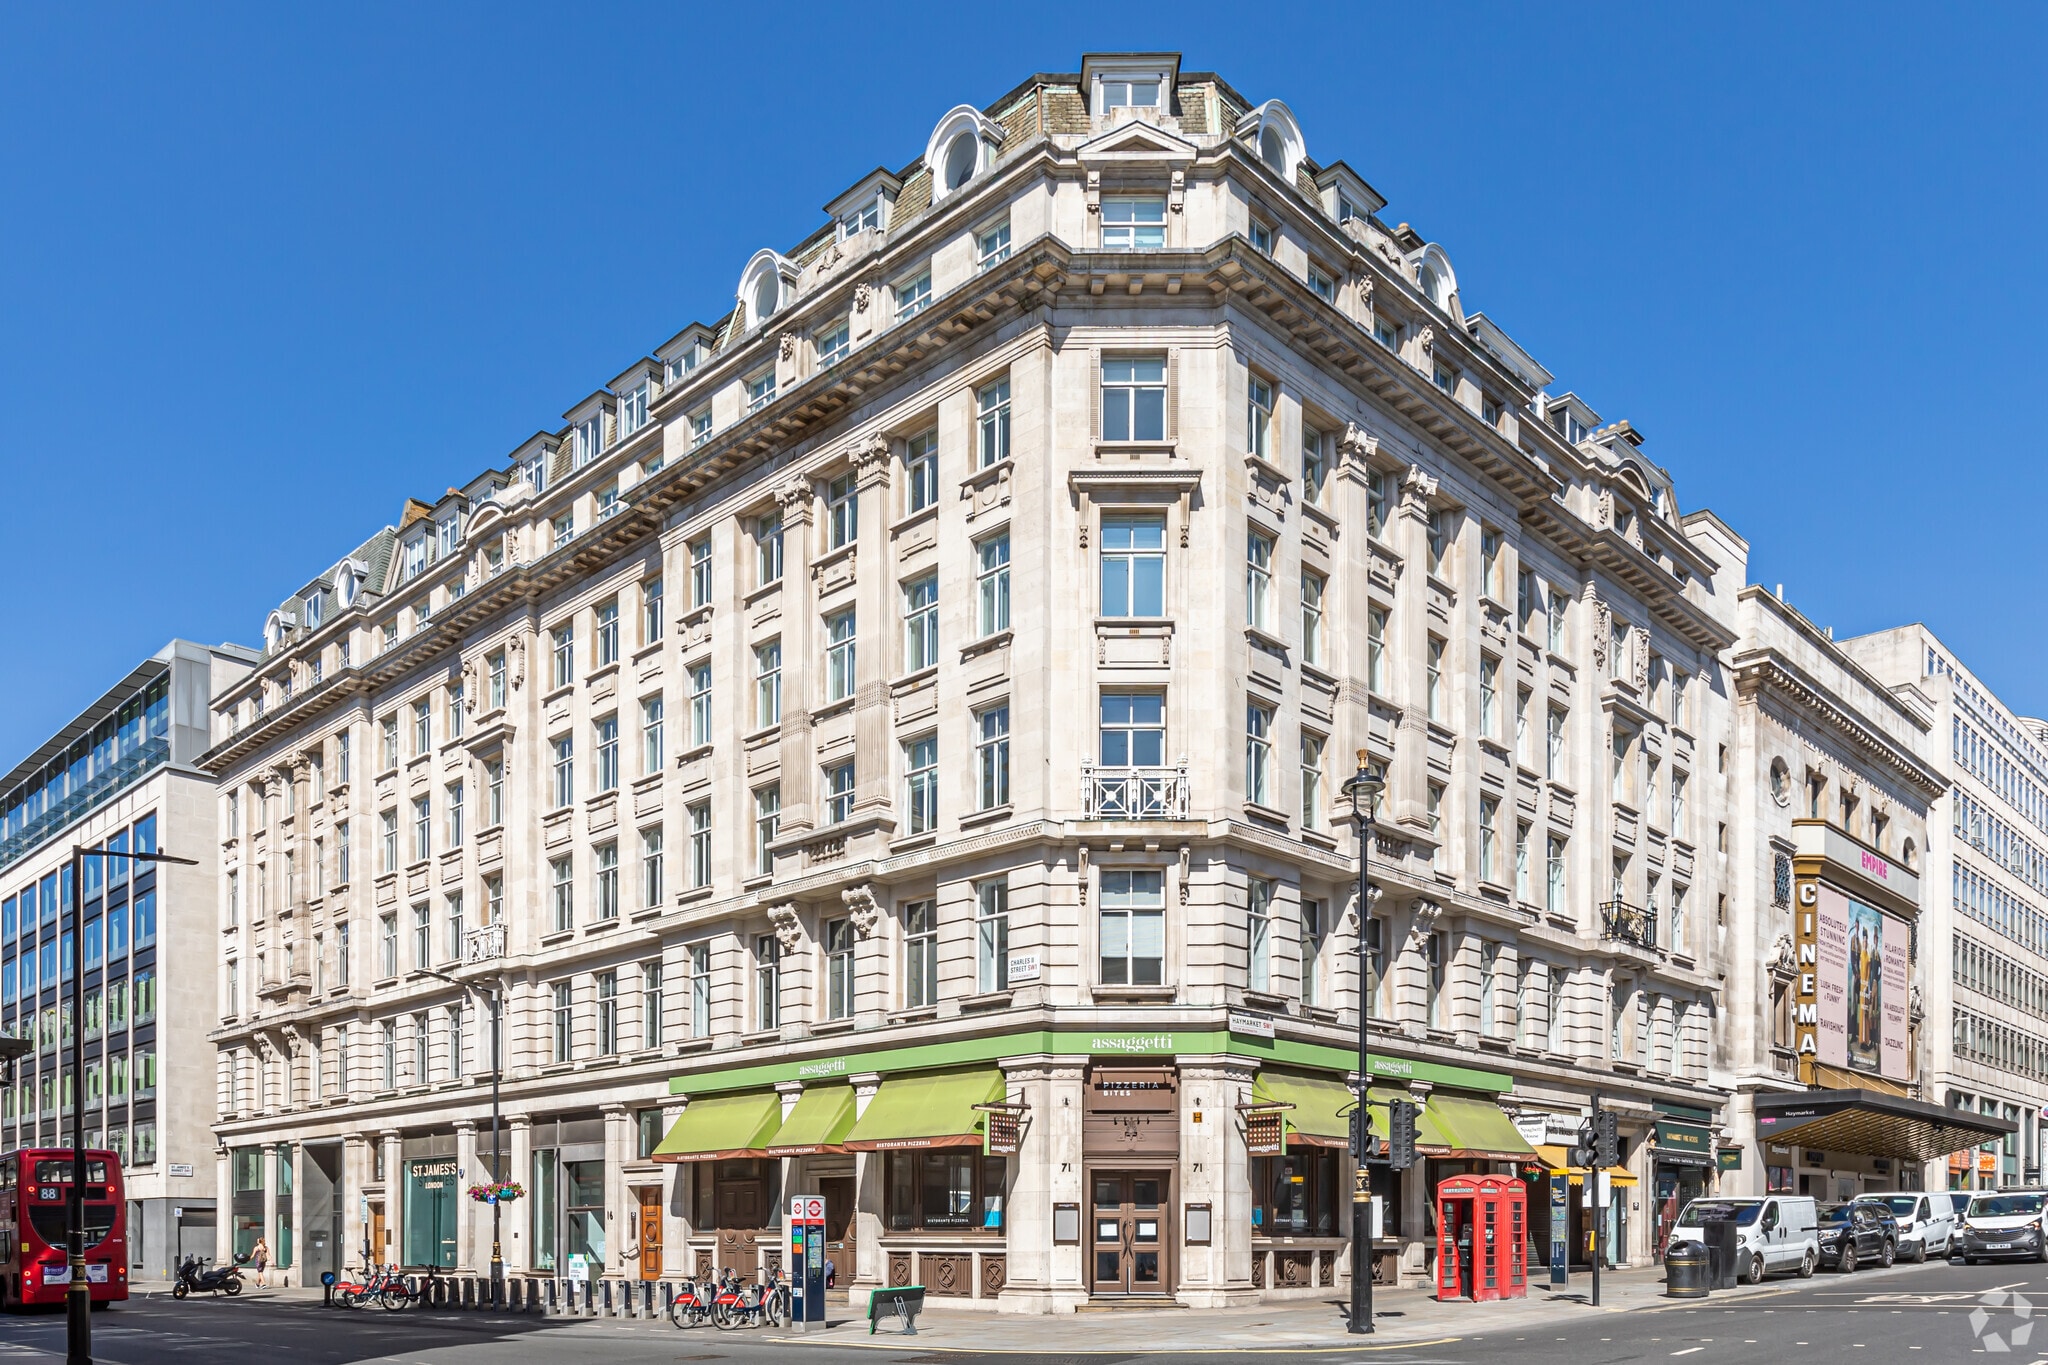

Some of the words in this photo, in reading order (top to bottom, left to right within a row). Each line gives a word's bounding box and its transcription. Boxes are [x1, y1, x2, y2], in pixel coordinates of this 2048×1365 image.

[1862, 850, 1887, 880] EMPIRE
[1820, 926, 1845, 945] STUNNING
[1010, 957, 1030, 967] CHARLES
[1010, 965, 1027, 974] STREET
[1027, 964, 1038, 972] SW1
[1799, 884, 1817, 1054] CINEMA
[1831, 984, 1844, 995] FRESH
[1231, 1017, 1262, 1028] HAYMARKET
[1091, 1033, 1173, 1052] assaggetti
[800, 1057, 845, 1076] assaggetti
[1374, 1061, 1412, 1075] assaggetti
[1559, 1127, 1574, 1136] House
[991, 1145, 1016, 1153] assaggetti
[1248, 1143, 1280, 1153] assaggetti
[412, 1165, 423, 1177] ST
[423, 1162, 457, 1177] JAMES'S
[1061, 1163, 1071, 1172] 71
[1193, 1163, 1203, 1173] 71
[425, 1181, 444, 1189] LONDON
[42, 1188, 56, 1199] 88
[606, 1211, 613, 1220] 16
